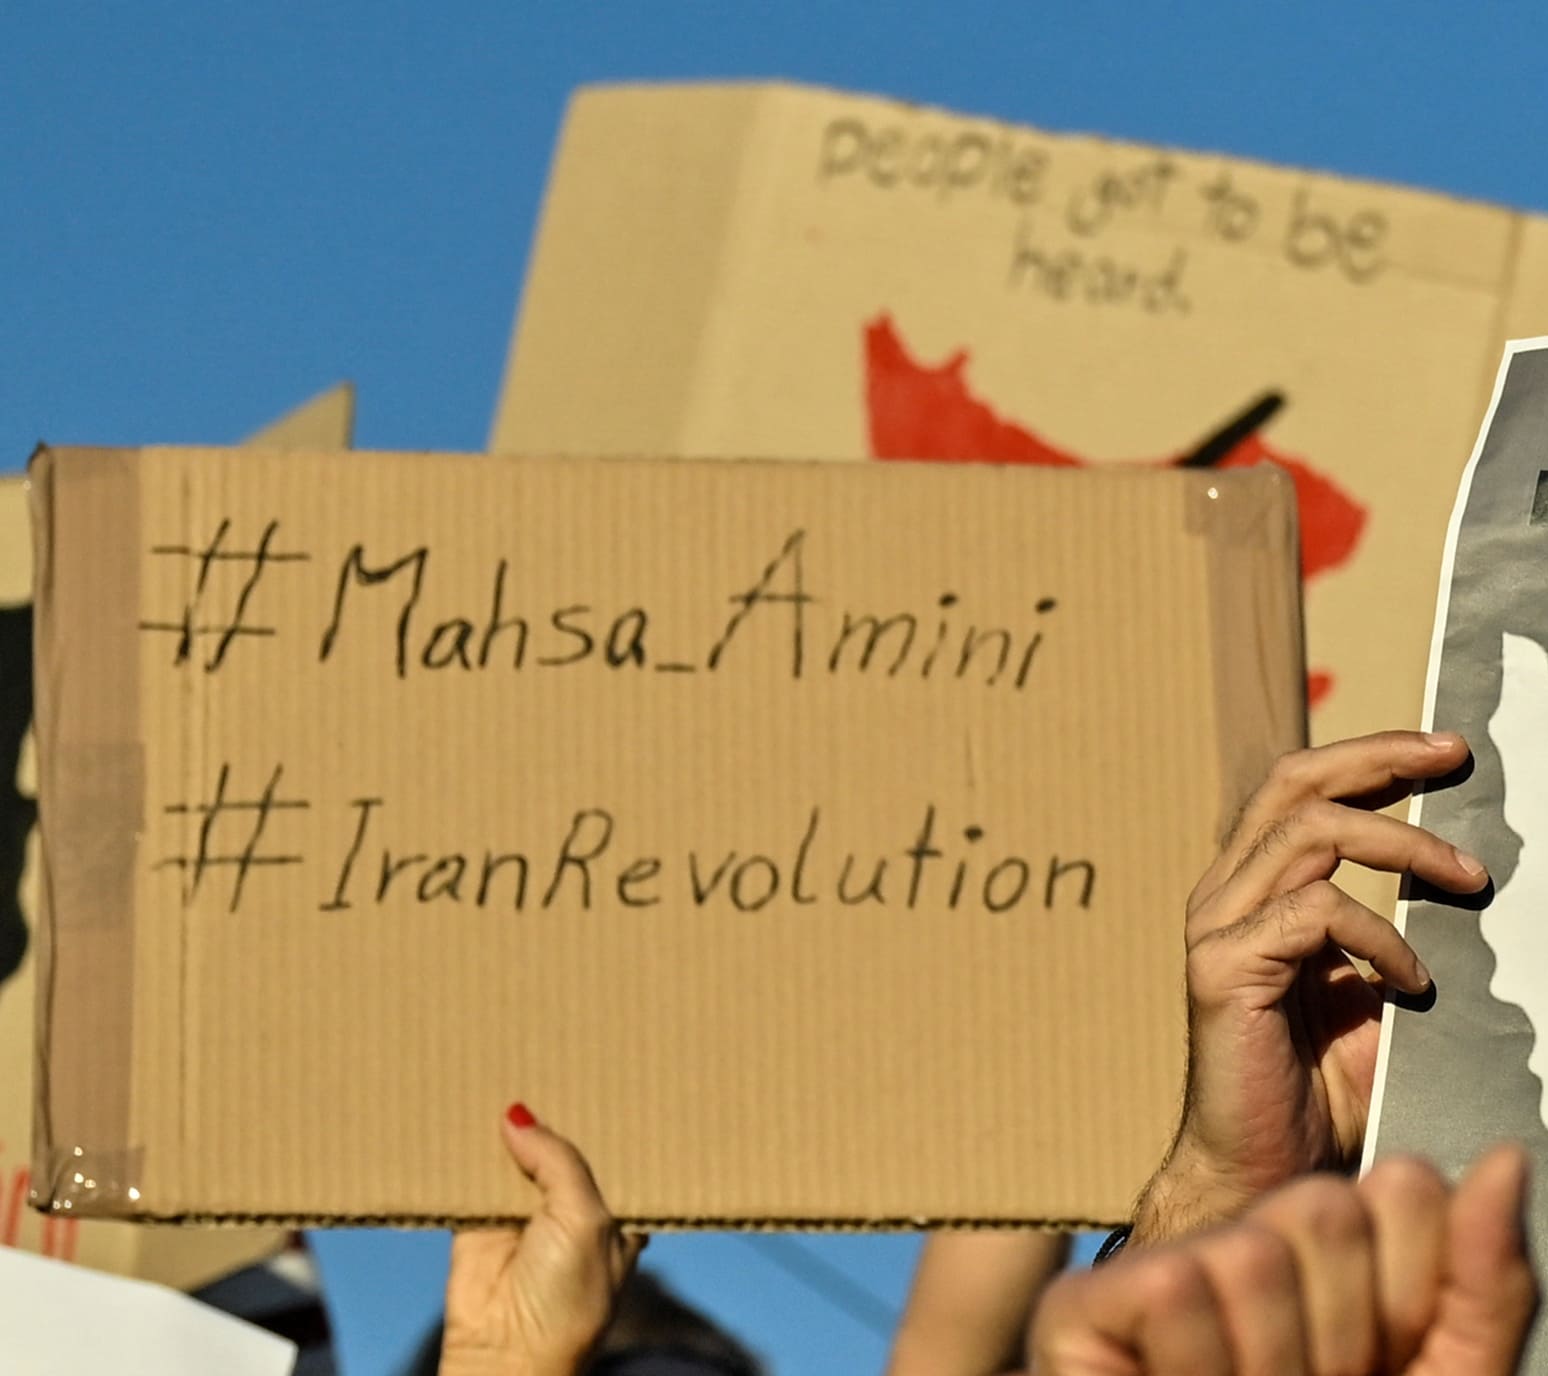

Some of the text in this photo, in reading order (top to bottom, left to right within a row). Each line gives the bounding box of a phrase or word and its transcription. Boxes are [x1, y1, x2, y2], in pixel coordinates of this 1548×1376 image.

[818, 117, 1391, 284] people got to be
[139, 519, 1057, 690] #Mahsa_Amini
[150, 764, 1095, 912] #IranRevolution
